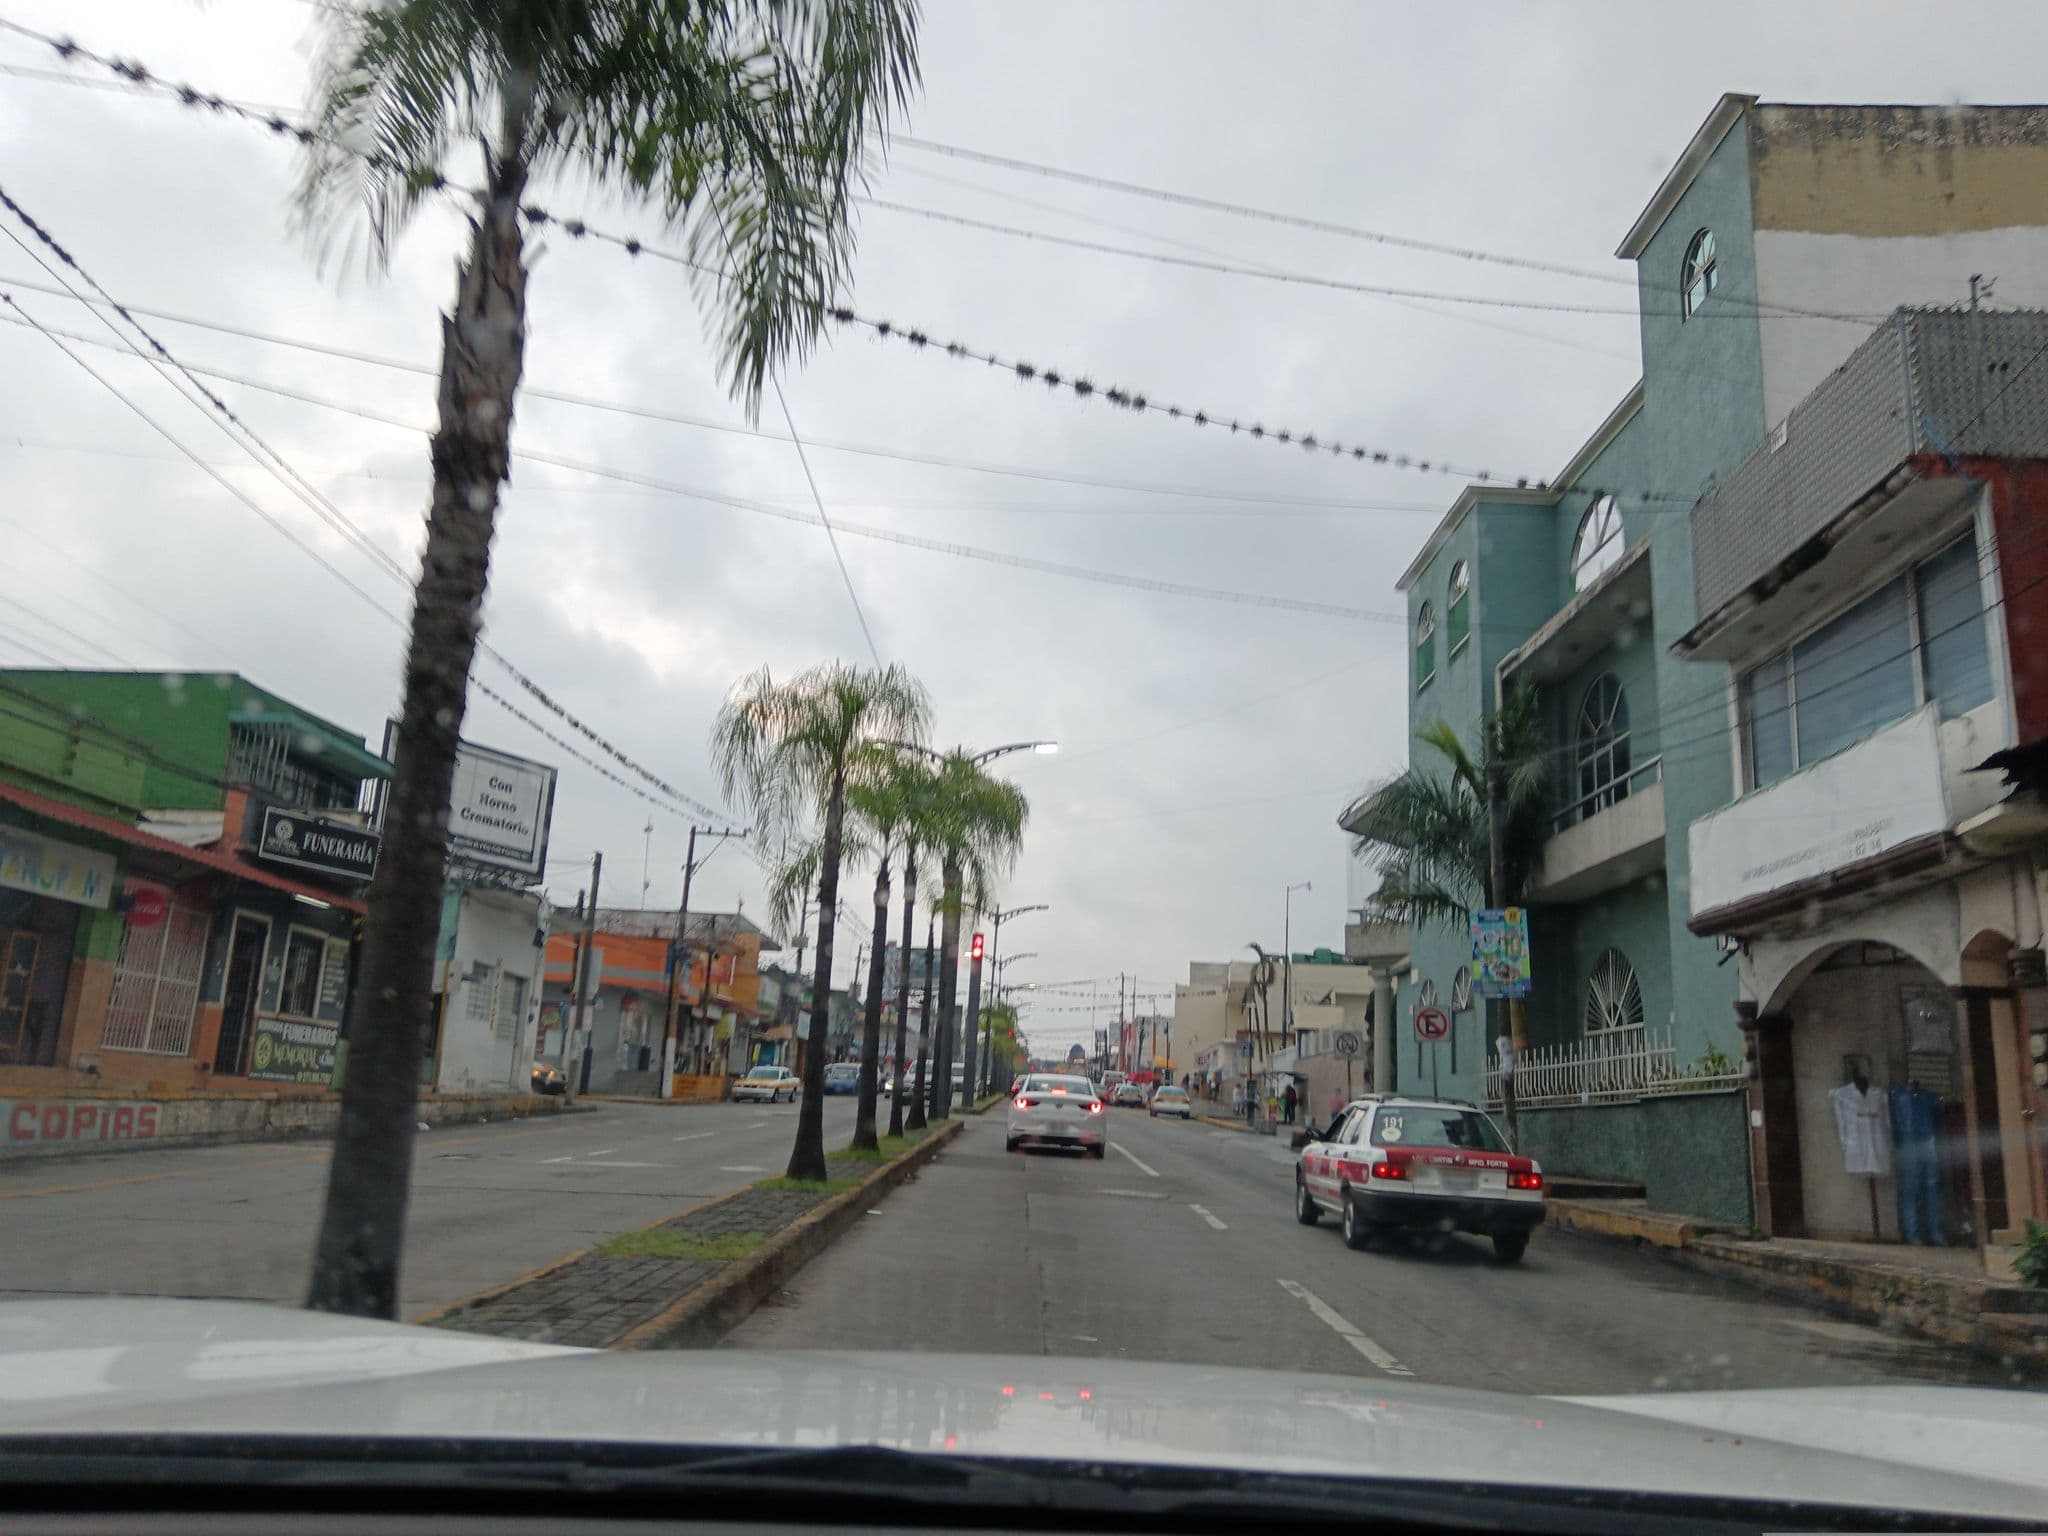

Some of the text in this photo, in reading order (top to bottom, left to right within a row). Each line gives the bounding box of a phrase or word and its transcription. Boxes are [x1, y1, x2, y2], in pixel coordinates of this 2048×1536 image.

[488, 775, 513, 793] Con
[480, 792, 517, 813] Horno
[460, 807, 529, 836] Crematorio
[303, 831, 373, 864] FUNERARÍA
[282, 1022, 338, 1047] FUNERARIOS
[9, 1103, 158, 1141] COPIAS
[1383, 1116, 1404, 1129] 191
